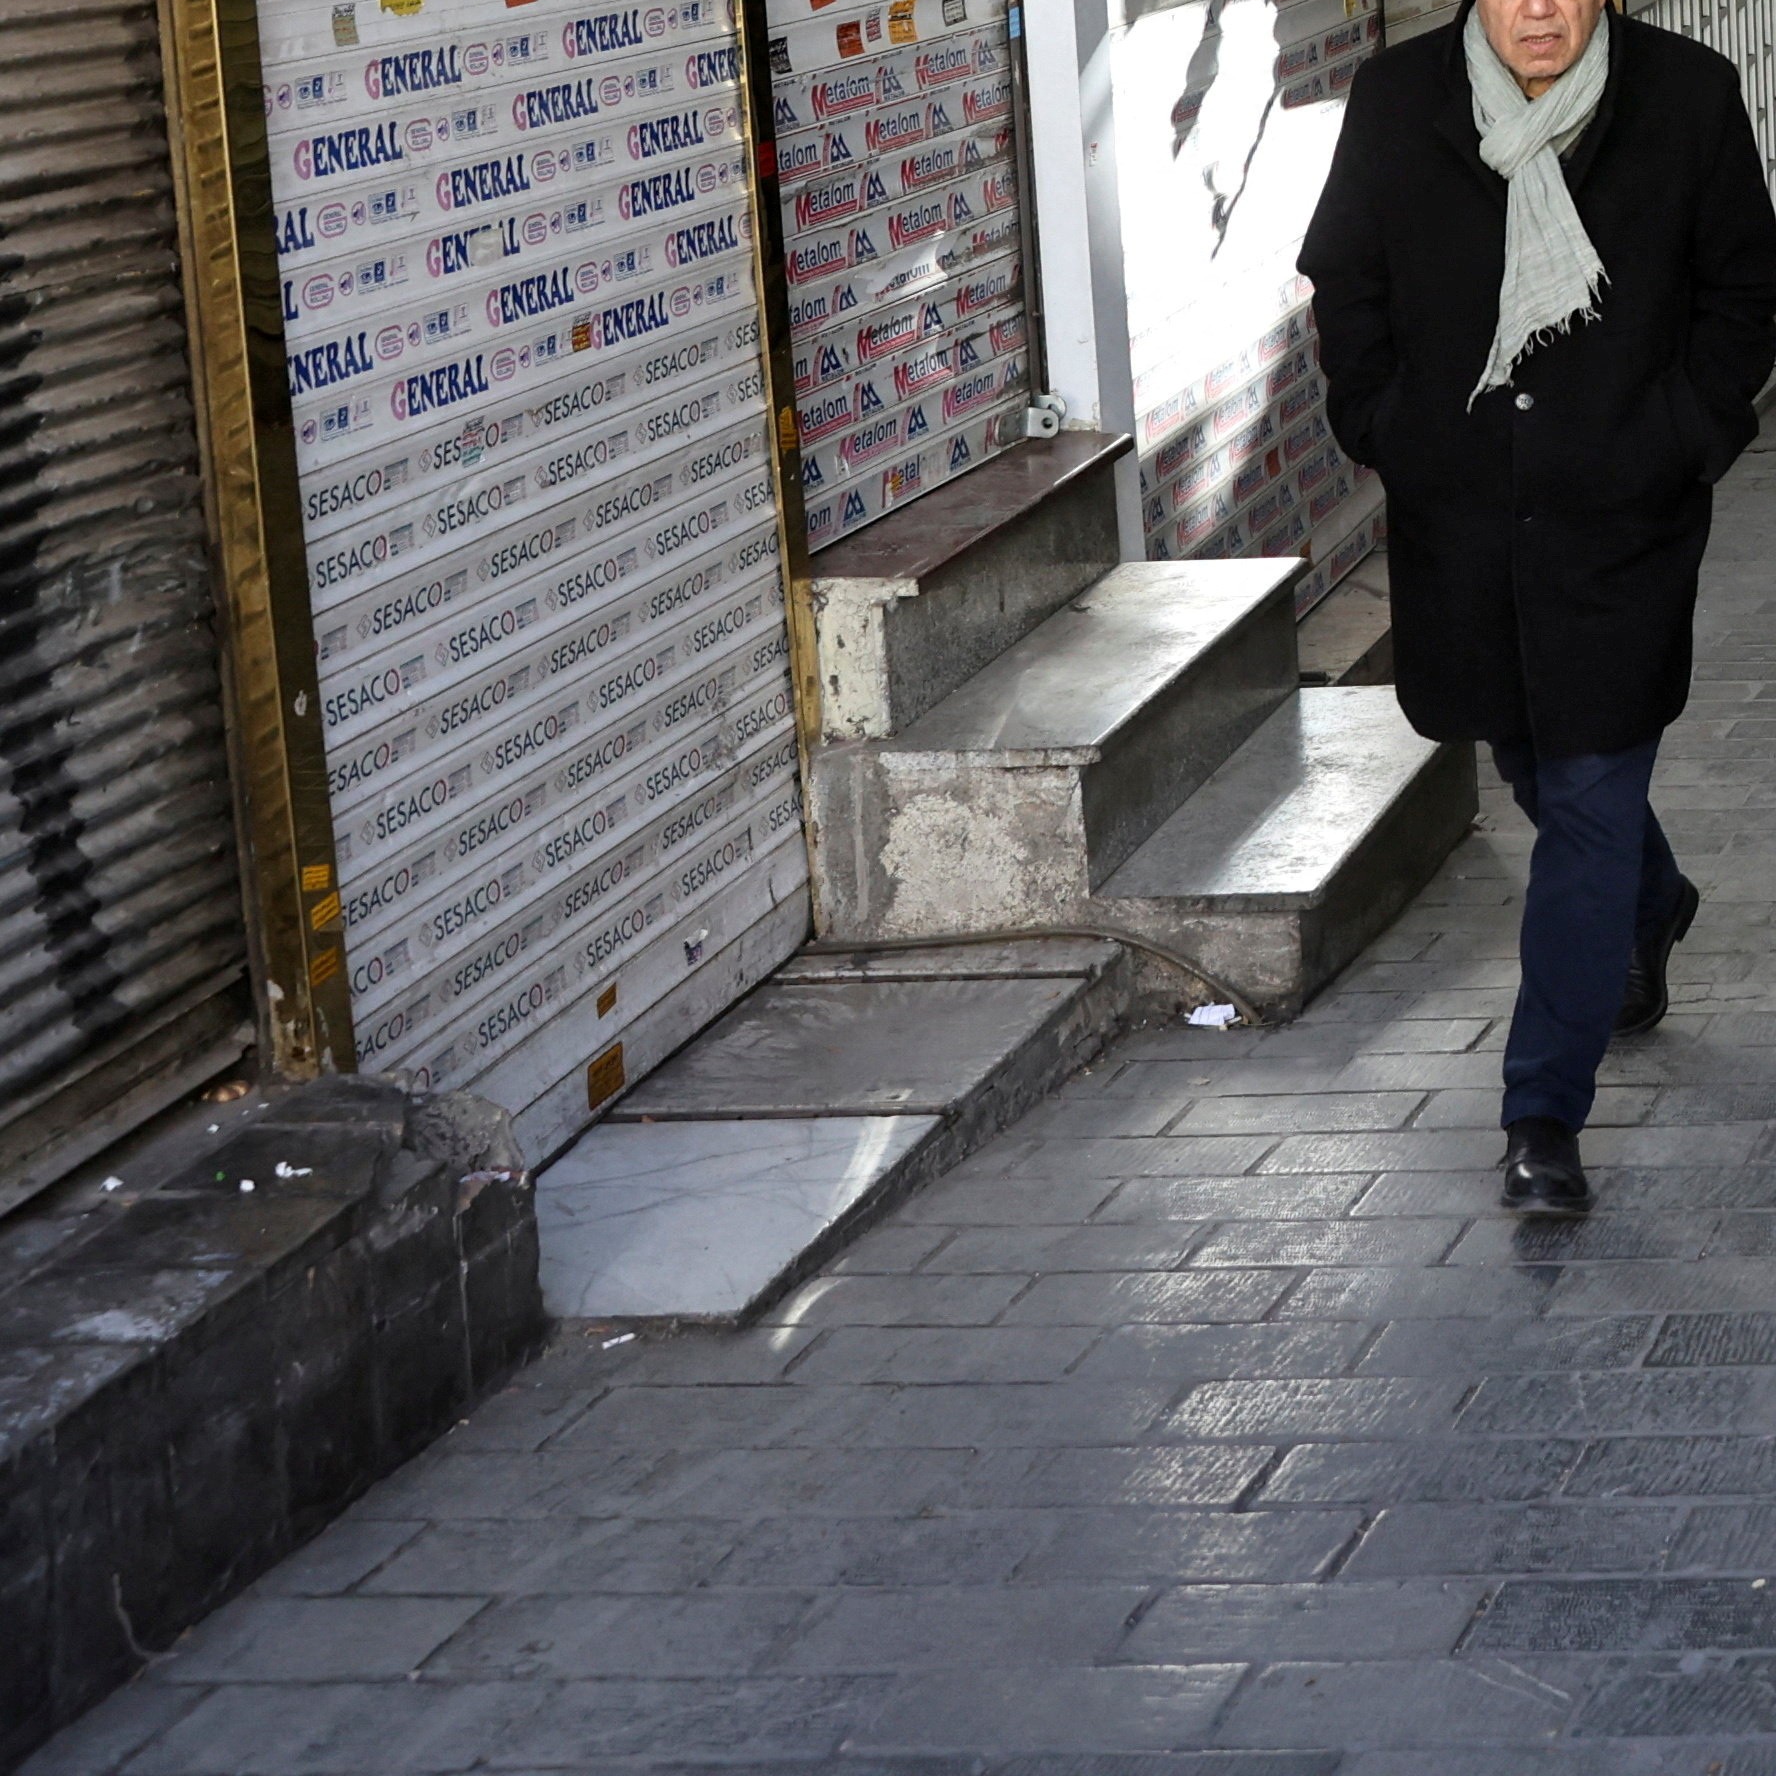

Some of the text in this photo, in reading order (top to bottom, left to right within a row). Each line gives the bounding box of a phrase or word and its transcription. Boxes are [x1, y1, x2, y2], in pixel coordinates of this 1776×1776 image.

[562, 9, 643, 60] GENERAL
[364, 44, 462, 100] GENERAL
[915, 46, 966, 90] Metalom
[512, 78, 598, 130] GENERAL
[811, 76, 869, 121] Metalom
[294, 122, 402, 181] GENERAL
[626, 109, 703, 160] GENERAL
[865, 110, 920, 152] Metalom
[436, 152, 530, 210] GENERAL
[618, 166, 694, 220] GENERAL
[901, 149, 953, 196] Metalom
[795, 181, 854, 233] Metalom
[888, 202, 942, 250] Metalom
[664, 216, 737, 268] GENERAL
[785, 238, 842, 285] Metalom
[485, 266, 575, 324] GENERAL
[588, 289, 669, 351] GENERAL
[956, 273, 1006, 318] Metalom
[644, 344, 699, 387] SESACO
[857, 314, 913, 365] Metalom
[390, 352, 490, 421] GENERAL
[895, 348, 948, 402] Metalom
[942, 371, 994, 425] Metalom
[542, 382, 604, 427] SESACO
[647, 398, 701, 441] SESACO
[548, 441, 607, 486] SESACO
[690, 441, 744, 484] SESACO
[839, 417, 897, 466] Metalom
[305, 469, 381, 523] SESACO
[436, 486, 504, 537] SESACO
[594, 481, 652, 529] SESACO
[490, 528, 554, 579] SESACO
[656, 509, 708, 557] SESACO
[315, 533, 388, 590] SESACO
[557, 557, 617, 607] SESACO
[372, 579, 443, 638] SESACO
[649, 571, 703, 619] SESACO
[448, 607, 514, 664] SESACO
[550, 623, 610, 675] SESACO
[694, 604, 745, 654] SESACO
[325, 667, 400, 727] SESACO
[439, 678, 507, 736] SESACO
[599, 656, 656, 711] SESACO
[664, 678, 717, 728] SESACO
[494, 714, 557, 771] SESACO
[737, 692, 786, 743] SESACO
[567, 732, 626, 788] SESACO
[647, 747, 701, 801] SESACO
[376, 777, 448, 841] SESACO
[458, 795, 523, 857] SESACO
[662, 797, 717, 850] SESACO
[545, 809, 606, 870] SESACO
[564, 860, 623, 920] SESACO
[682, 841, 734, 898] SESACO
[432, 878, 501, 943] SESACO
[453, 931, 520, 998] SESACO
[585, 908, 644, 969] SESACO
[478, 980, 543, 1052] SESACO
